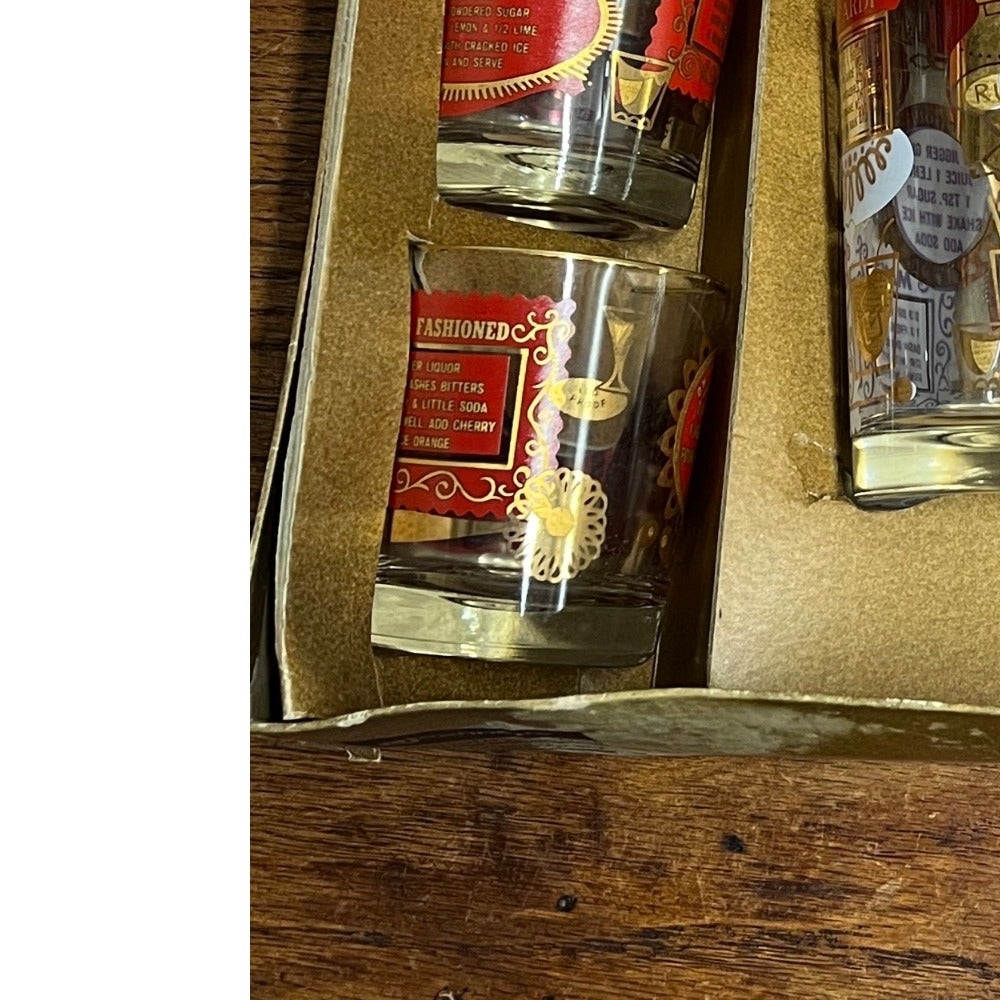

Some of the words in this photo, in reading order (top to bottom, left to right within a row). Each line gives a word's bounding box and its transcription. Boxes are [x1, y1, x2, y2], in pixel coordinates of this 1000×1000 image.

[497, 7, 530, 17] SUGAR
[514, 25, 538, 36] LIME
[465, 41, 507, 51] CRACKED
[514, 43, 529, 53] ICE
[473, 58, 504, 68] SERVE
[416, 318, 510, 341] FASHIONED
[426, 362, 460, 373] LIQUOR
[441, 381, 484, 394] BITTERS
[422, 399, 454, 411] LITTLE
[460, 401, 488, 413] SODA
[429, 419, 448, 430] ADD
[453, 420, 496, 432] CHERRY
[414, 436, 450, 449] ORANGE
